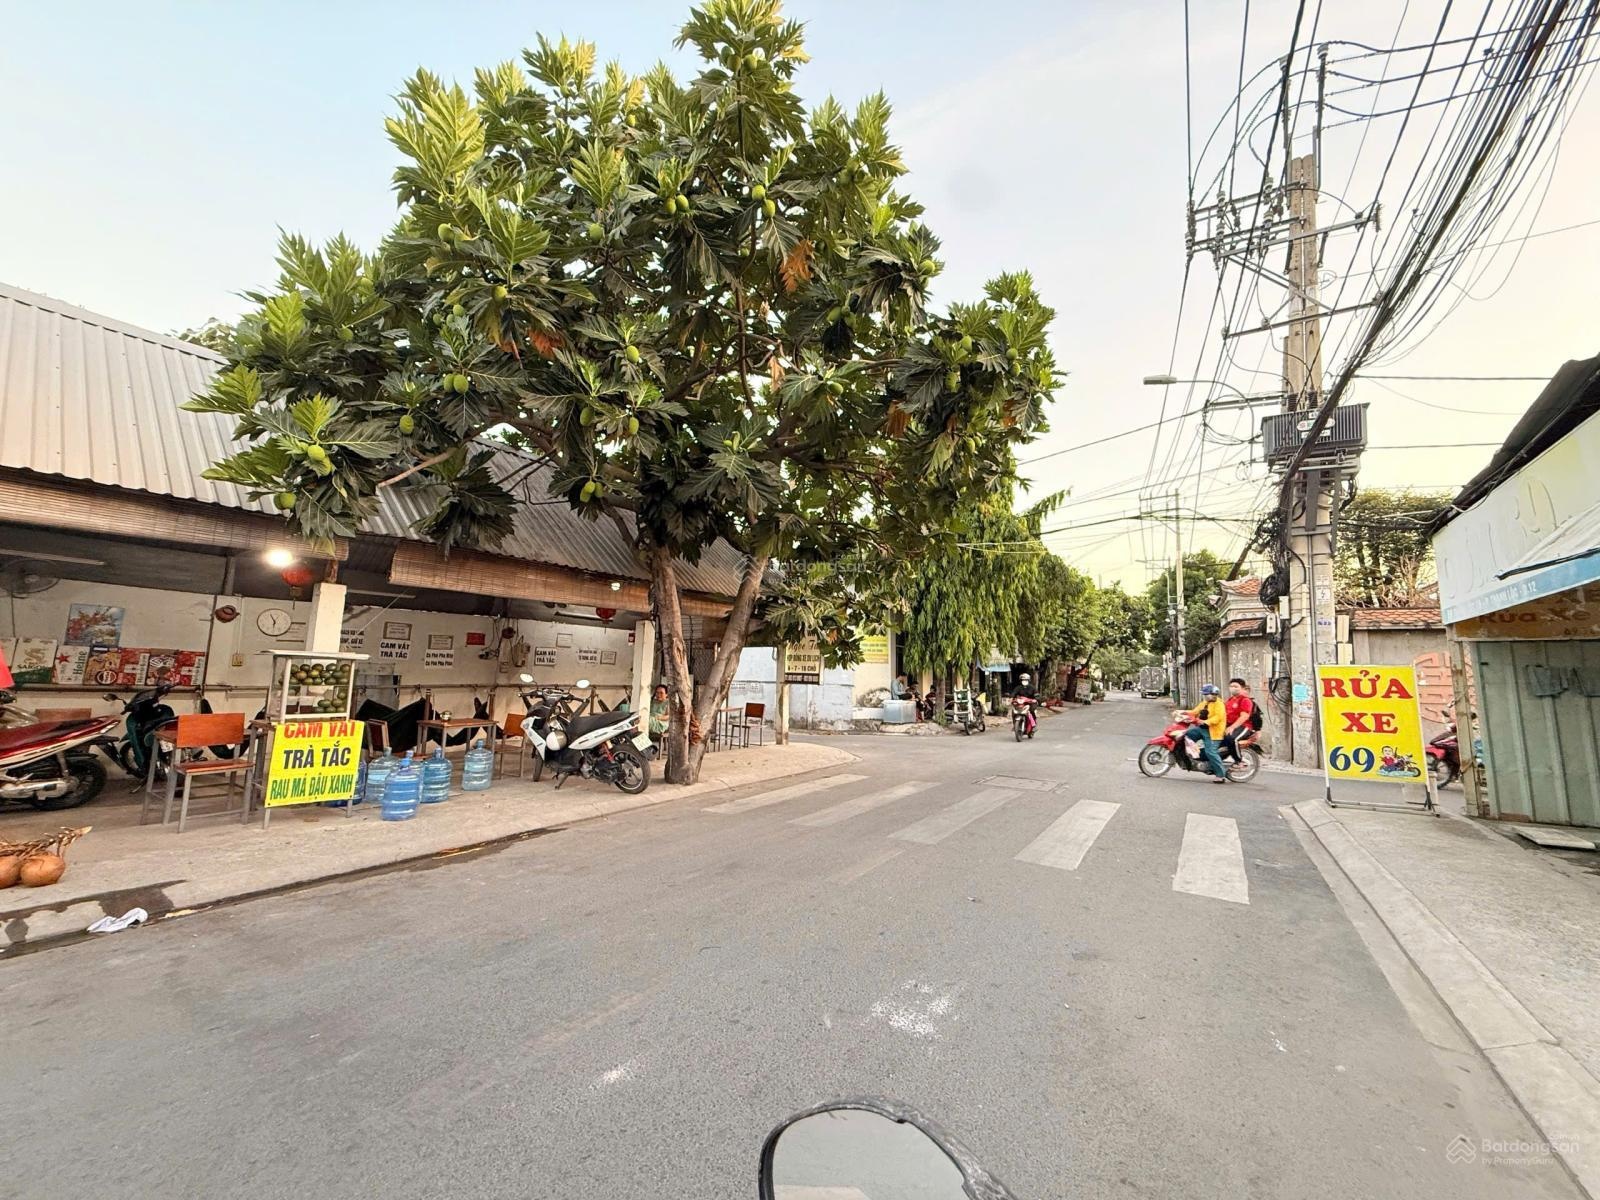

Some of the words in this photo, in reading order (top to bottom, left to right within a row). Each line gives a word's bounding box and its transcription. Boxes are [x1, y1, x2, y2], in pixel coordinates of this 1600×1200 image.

[1320, 669, 1414, 700] RỬA
[1341, 712, 1399, 734] XE
[283, 745, 314, 769] TRÀ
[321, 740, 351, 768] TẮC
[1329, 746, 1376, 773] 69
[270, 778, 290, 800] RAU
[291, 772, 307, 798] MÁ
[328, 774, 354, 794] XANH
